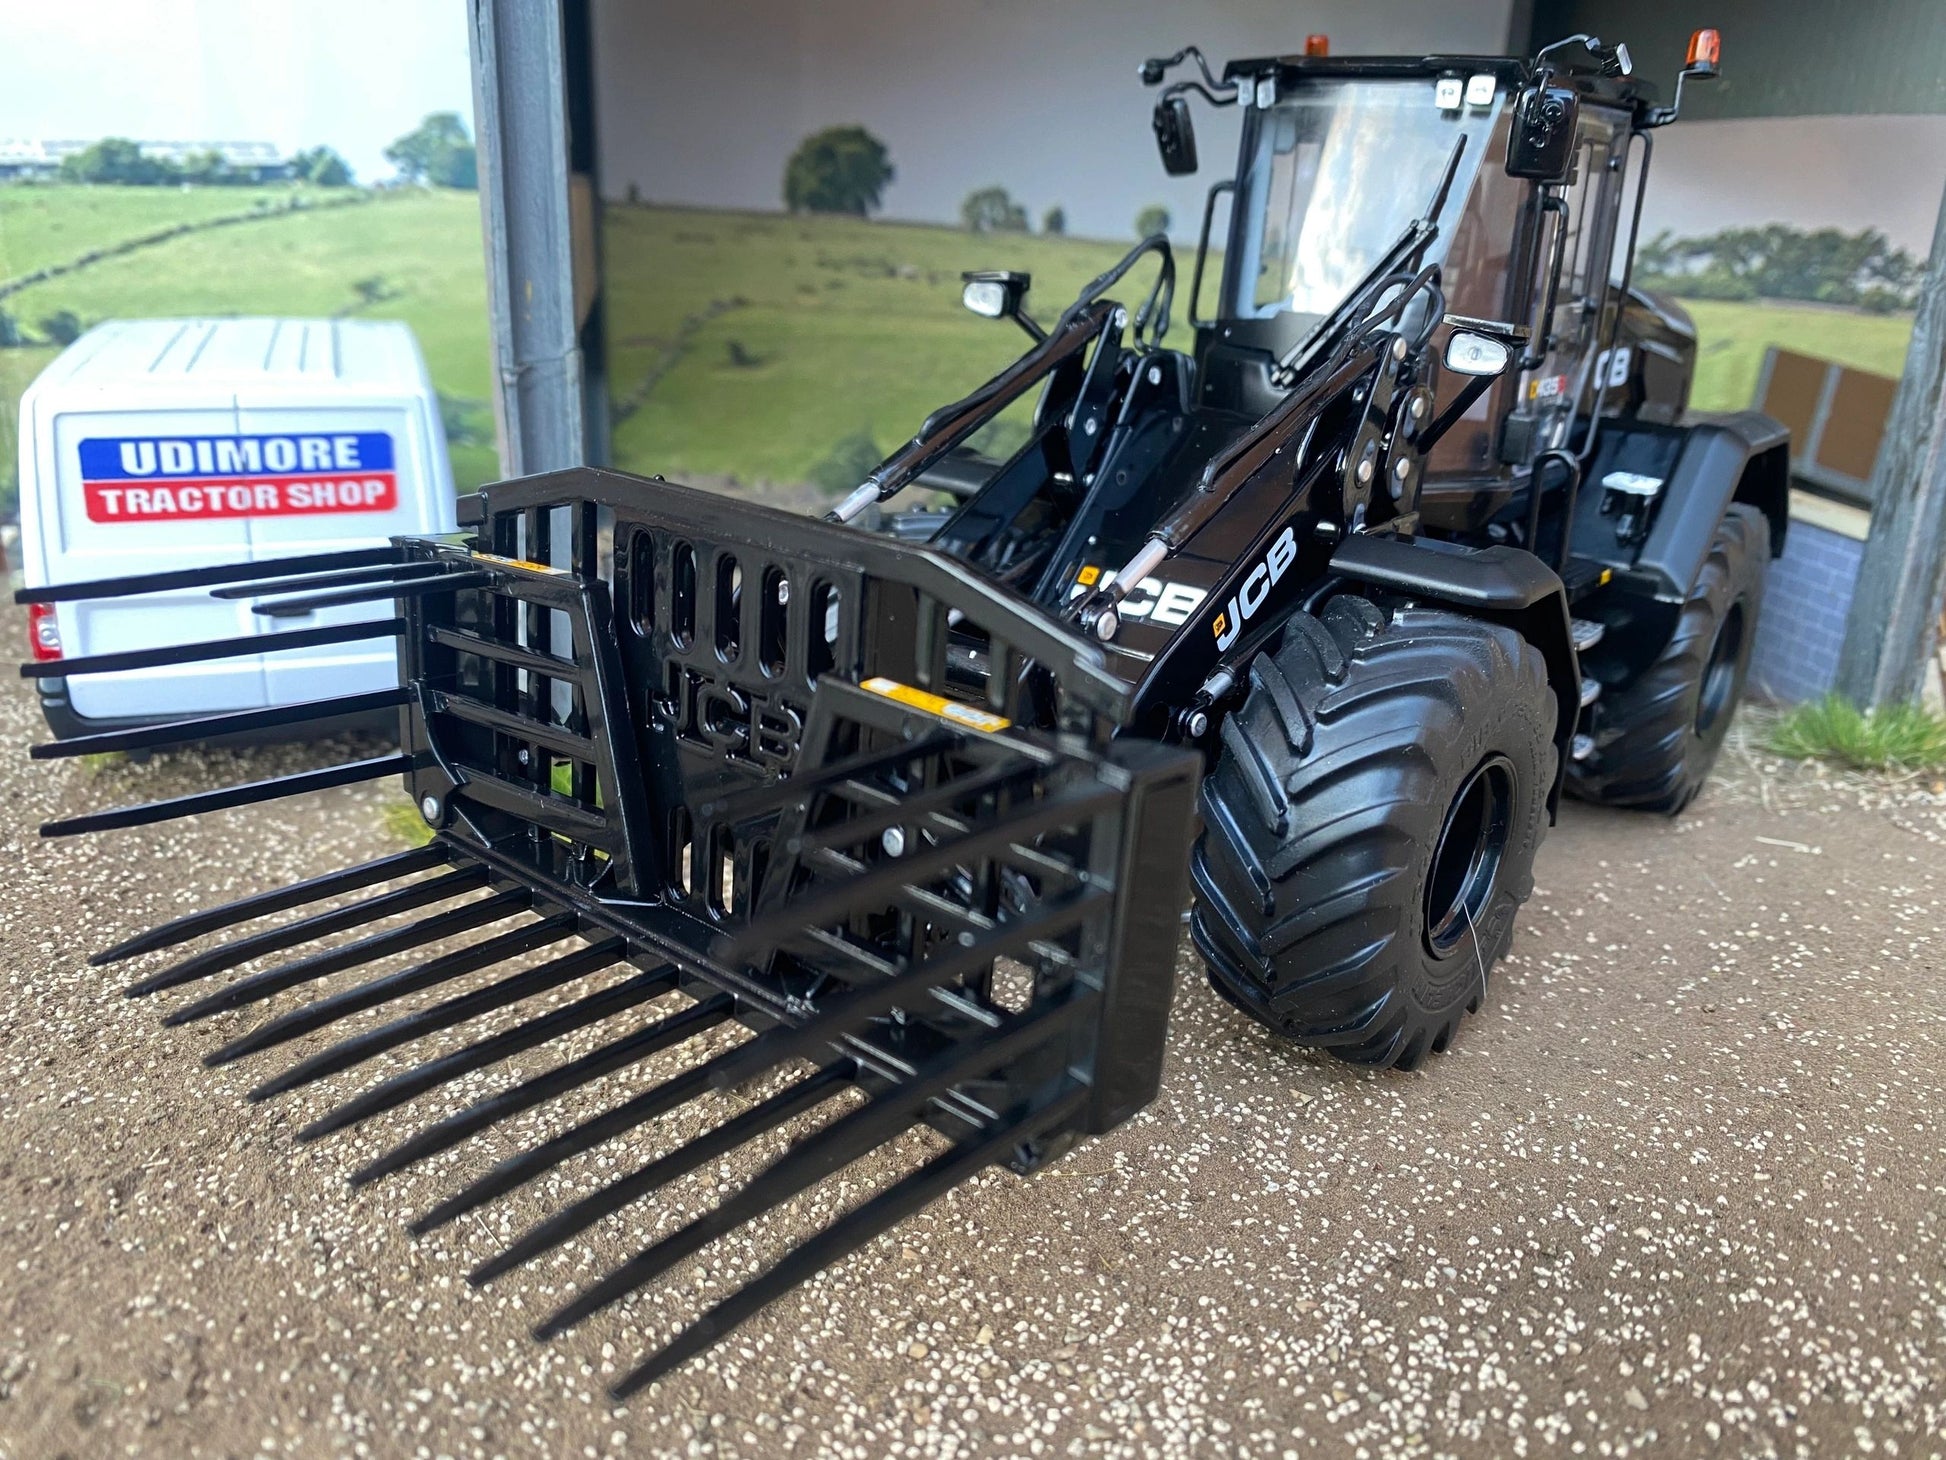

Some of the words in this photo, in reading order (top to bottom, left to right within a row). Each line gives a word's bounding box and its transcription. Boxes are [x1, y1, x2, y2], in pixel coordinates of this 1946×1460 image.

[1594, 347, 1631, 391] CB
[119, 436, 362, 475] UDIMORE
[98, 482, 280, 515] TRACTOR
[286, 479, 387, 507] SHOP
[1216, 525, 1298, 652] JCB
[651, 660, 803, 766] JCB
